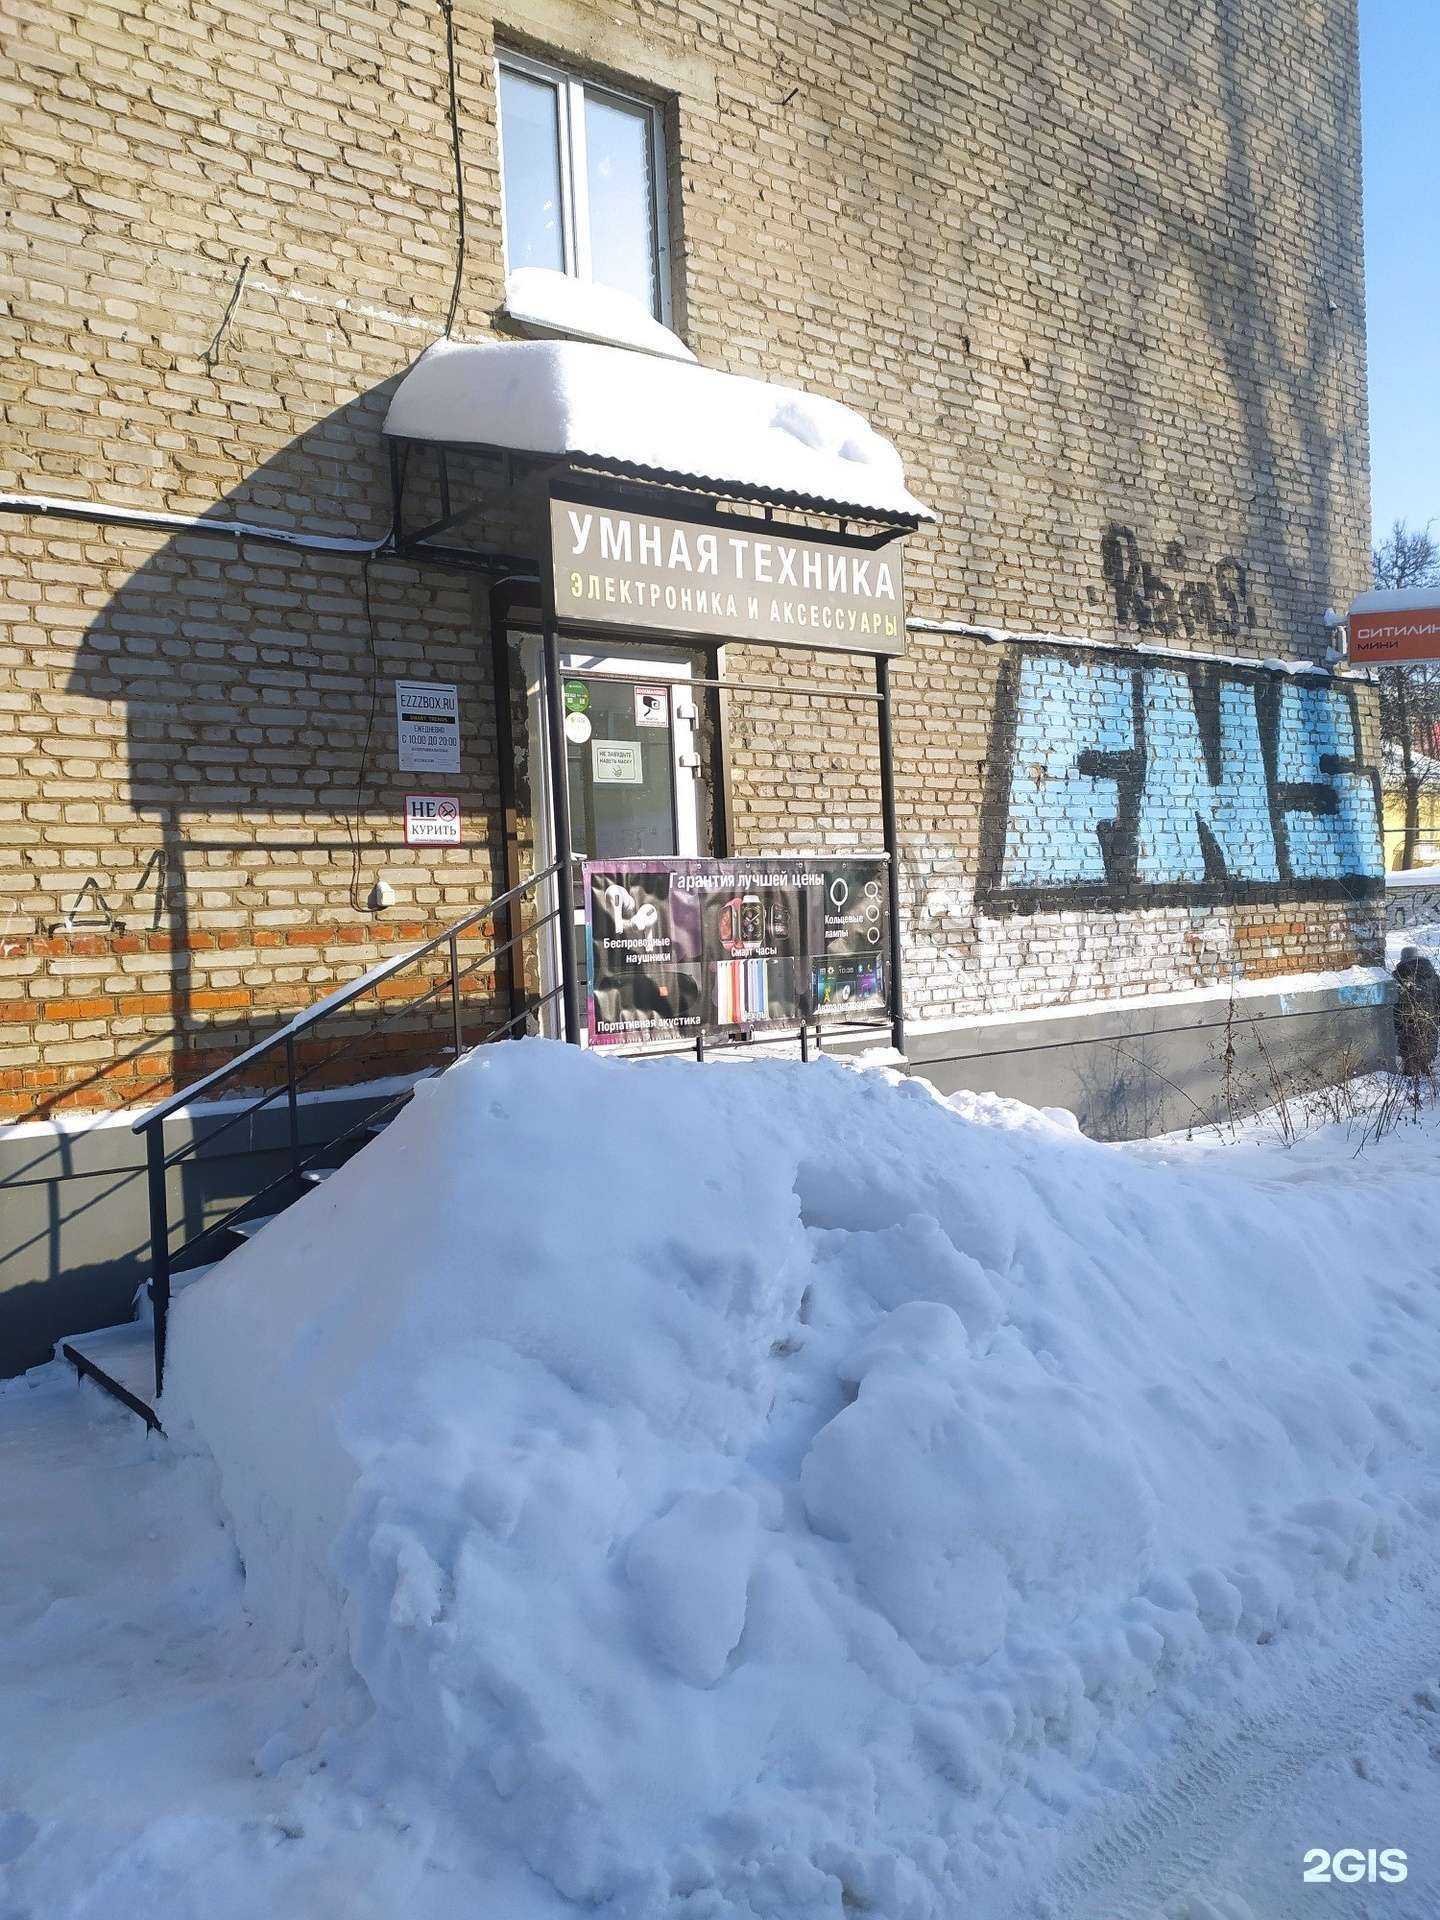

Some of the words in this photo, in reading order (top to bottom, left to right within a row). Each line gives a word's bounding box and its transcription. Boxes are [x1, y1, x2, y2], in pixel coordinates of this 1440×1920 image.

[568, 511, 719, 576] УМНАЯ
[729, 538, 895, 600] ТЕХНИКА
[571, 572, 738, 617] ЭЛЕКТРОНИКА
[748, 596, 759, 620] И
[770, 600, 897, 637] АКСЕССУАРЫ
[1357, 640, 1399, 650] МИНИ
[401, 694, 455, 710] EZZZBOX.RU
[428, 735, 438, 746] ДО
[411, 801, 437, 817] НЕ
[411, 824, 457, 835] КУРИТЬ
[669, 872, 735, 891] Гарантия
[737, 870, 788, 890] лучшей
[791, 872, 825, 889] цены
[824, 914, 864, 925] Кольцевые
[824, 930, 849, 938] лампы
[603, 937, 671, 949] Беспроводные
[731, 948, 752, 957] Смарт
[755, 946, 777, 956] часы
[625, 952, 671, 964] наушники
[597, 1018, 657, 1032] Портативная
[659, 1015, 701, 1028] акустика
